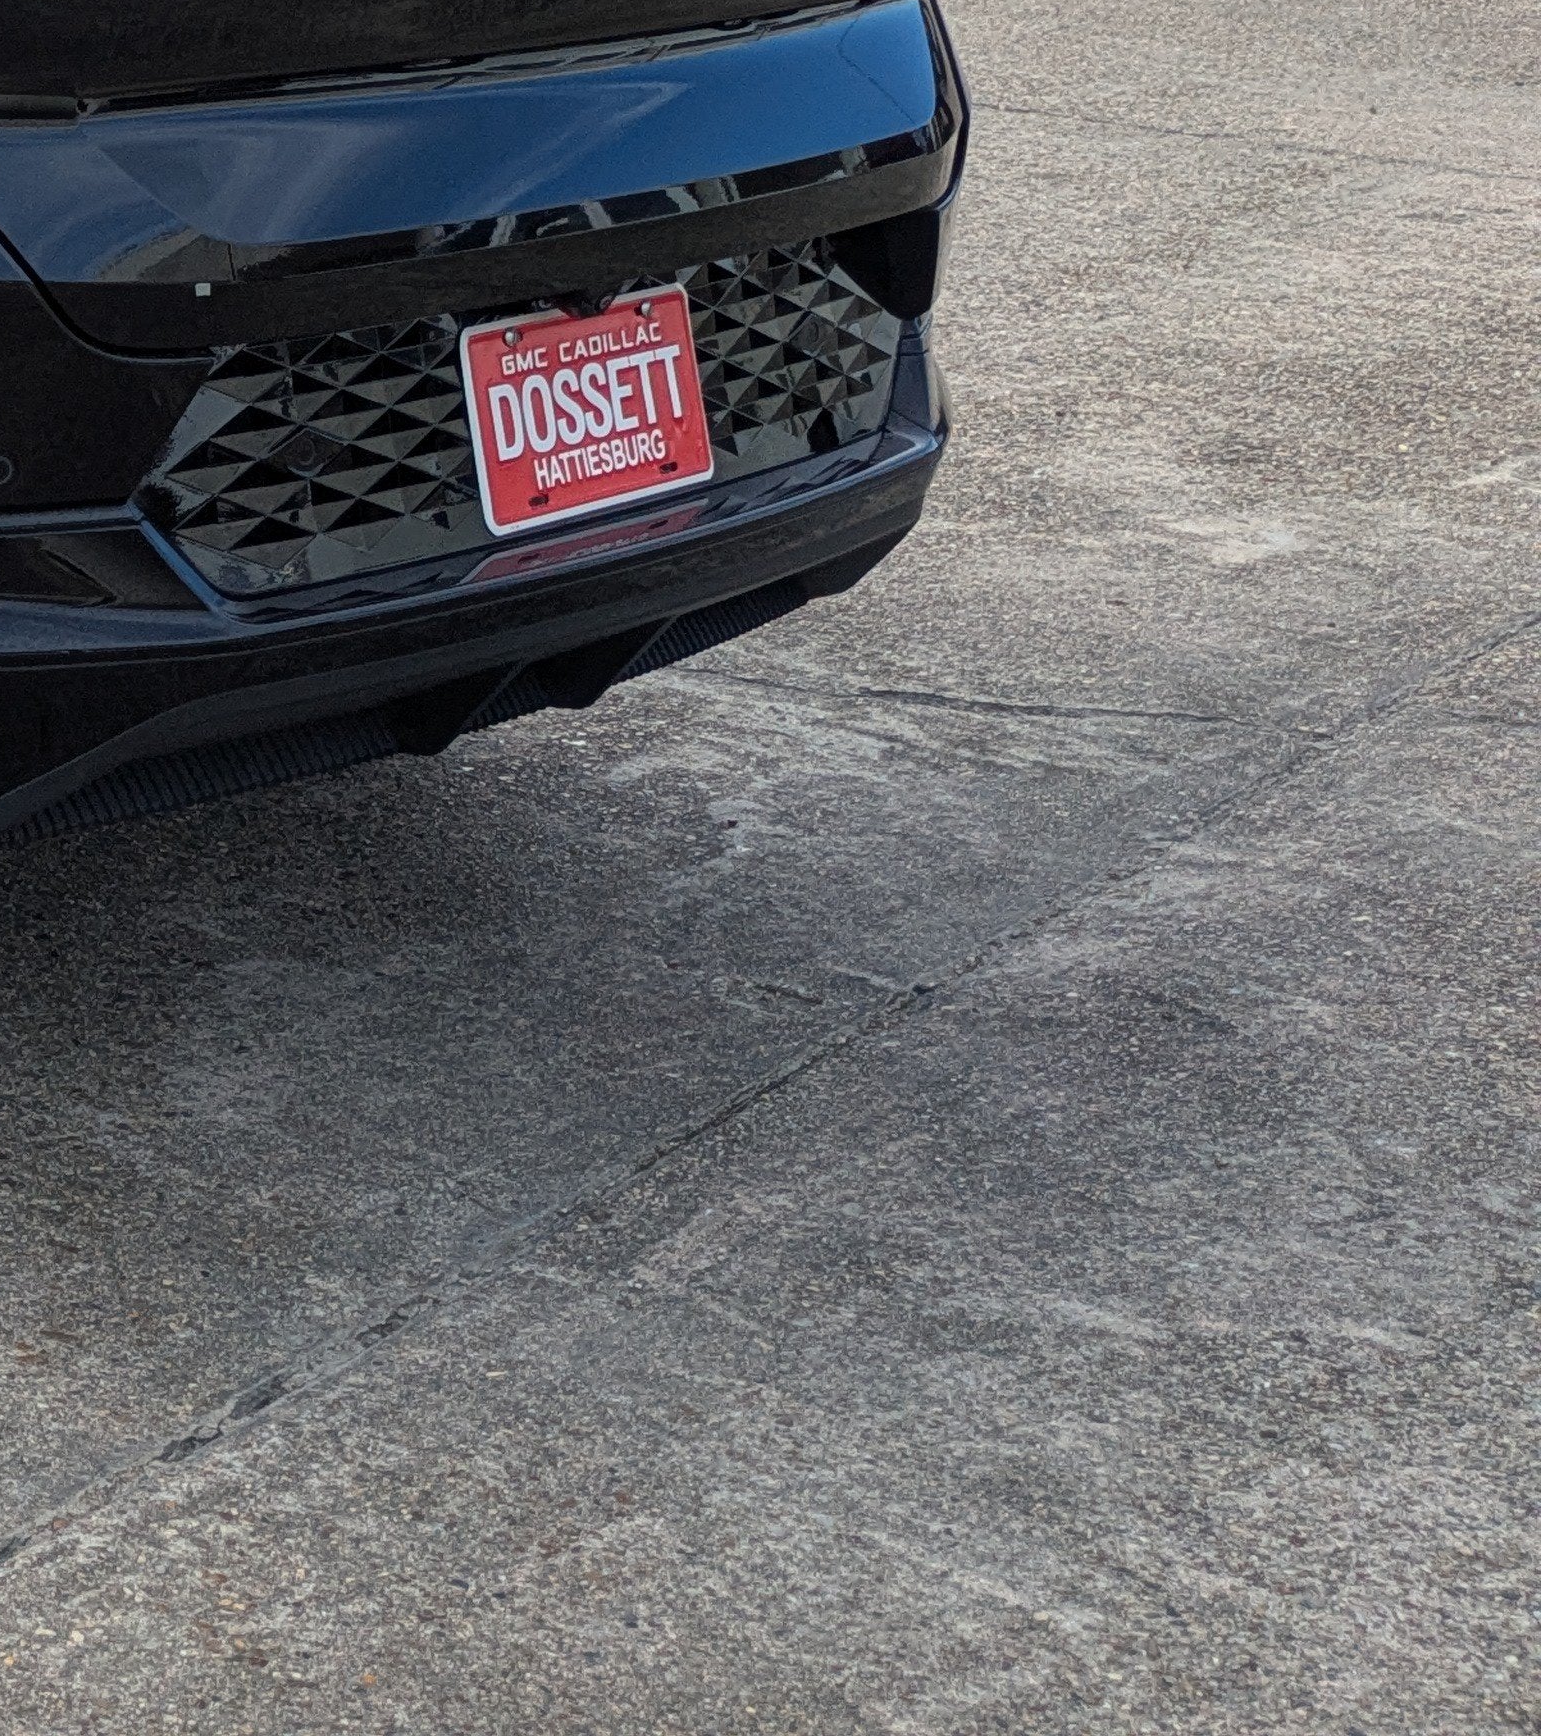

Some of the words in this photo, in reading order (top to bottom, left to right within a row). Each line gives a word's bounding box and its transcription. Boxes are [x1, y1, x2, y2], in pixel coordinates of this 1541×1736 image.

[500, 346, 549, 376] GMC
[558, 321, 663, 363] CADILLAC
[487, 344, 683, 463] DOSSETT
[533, 428, 667, 492] HATTIESBURG
